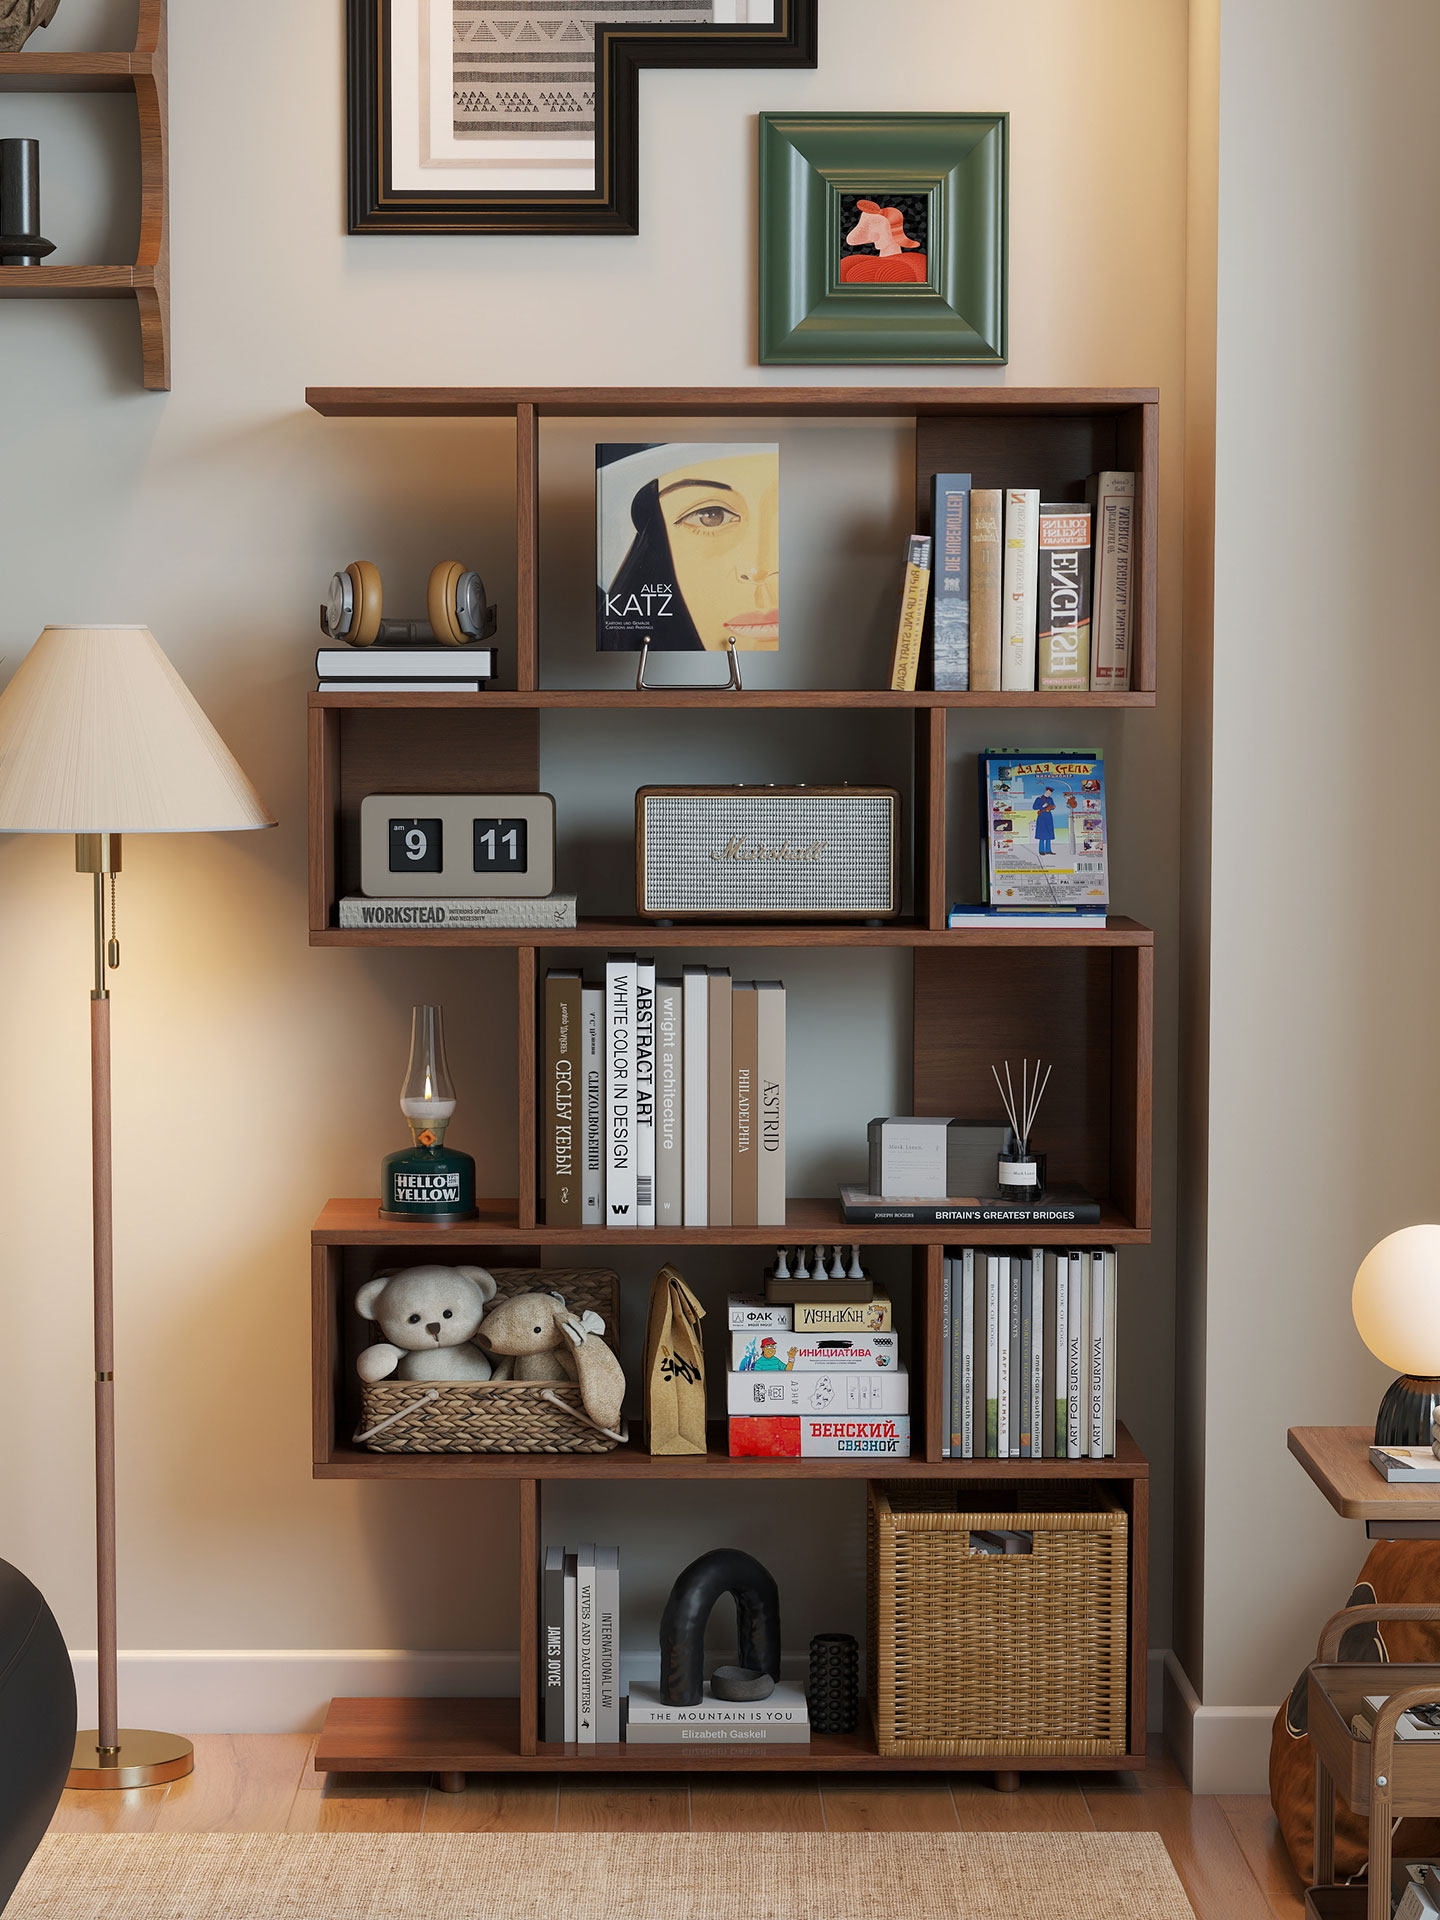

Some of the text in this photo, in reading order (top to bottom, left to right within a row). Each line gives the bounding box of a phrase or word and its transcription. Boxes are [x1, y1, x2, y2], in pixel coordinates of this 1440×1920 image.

[641, 584, 672, 593] ALEX
[605, 594, 674, 616] KATZ
[1018, 764, 1090, 775] ДЯДЯ СТЕПА
[405, 830, 427, 861] 9
[480, 829, 518, 860] 11
[712, 834, 830, 860] Marshall
[362, 906, 446, 924] WORKSTEAD
[636, 986, 653, 1127] ABSTRACT ART
[614, 976, 628, 1168] WHITE COLOR IN DESIGN
[660, 997, 679, 1149] wright architecture
[738, 1069, 750, 1152] PHILADELPHIA
[764, 1080, 780, 1152] ÆSTRID
[398, 1176, 446, 1188] HELLO
[398, 1188, 456, 1200] YELLOW
[936, 1211, 980, 1220] BRITAIN'S
[983, 1211, 1030, 1220] GREATEST
[1033, 1211, 1075, 1220] BRIDGES
[746, 1312, 772, 1321] ФАК
[799, 1349, 872, 1358] ИНИЦИАТИВА
[1070, 1337, 1078, 1446] ART FOR SURVIVAL
[1093, 1337, 1102, 1446] ART FOR SURVIVAL
[810, 1420, 900, 1438] ВЕНСКИЙ
[838, 1440, 900, 1452] СВЯЗНОЙ
[548, 1626, 561, 1687] JAMES JOYCE
[582, 1584, 590, 1714] WIVES AND DAUGHTERS
[602, 1612, 612, 1708] INTERNATIONAL LAW
[682, 1729, 766, 1739] Elizabeth Gaskell
